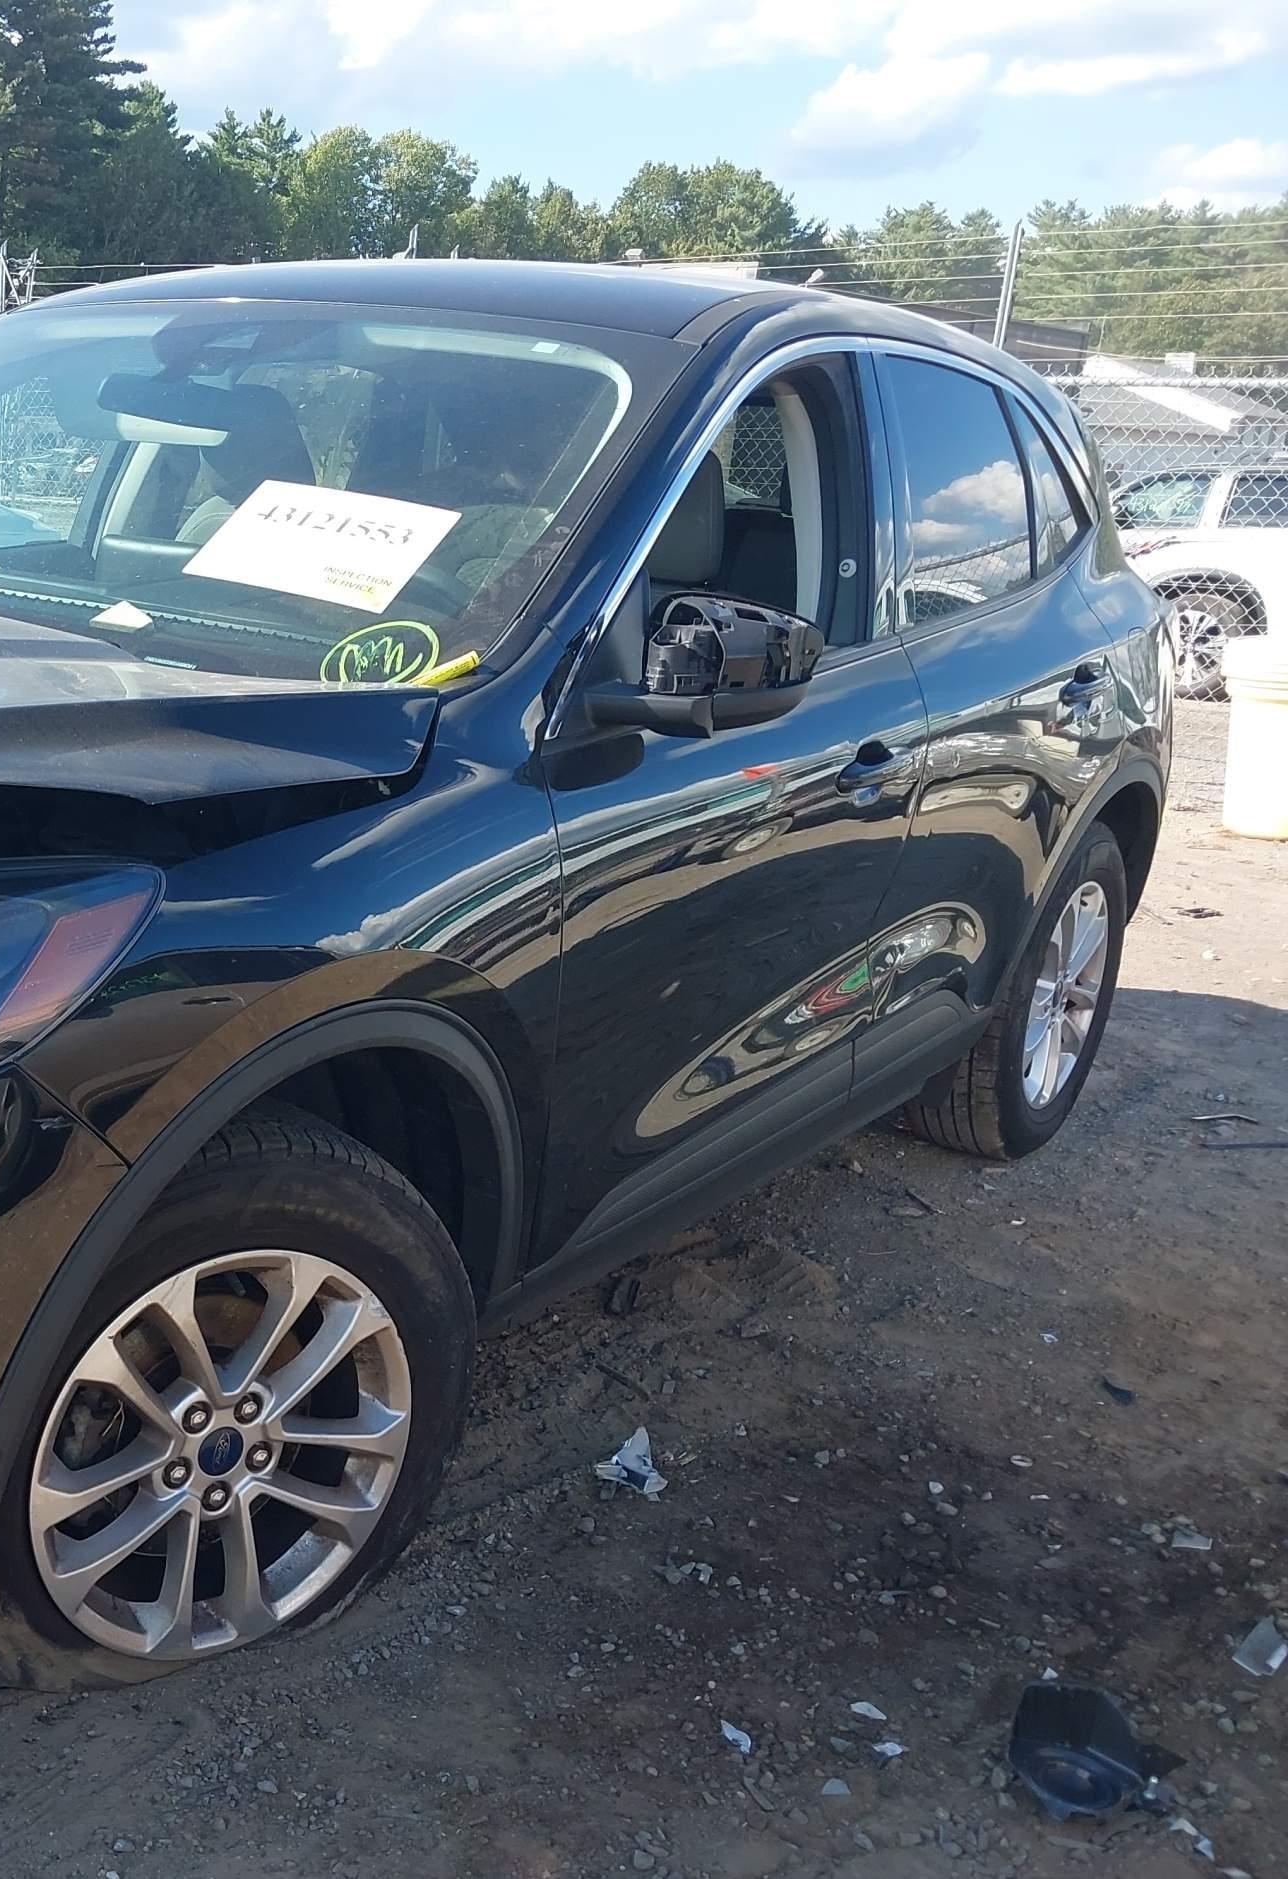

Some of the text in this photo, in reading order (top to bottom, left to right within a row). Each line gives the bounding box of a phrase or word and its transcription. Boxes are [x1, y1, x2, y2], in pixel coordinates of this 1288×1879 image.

[257, 504, 414, 544] 43121553
[323, 565, 393, 588] INSPECTION
[325, 575, 376, 595] SERVICE
